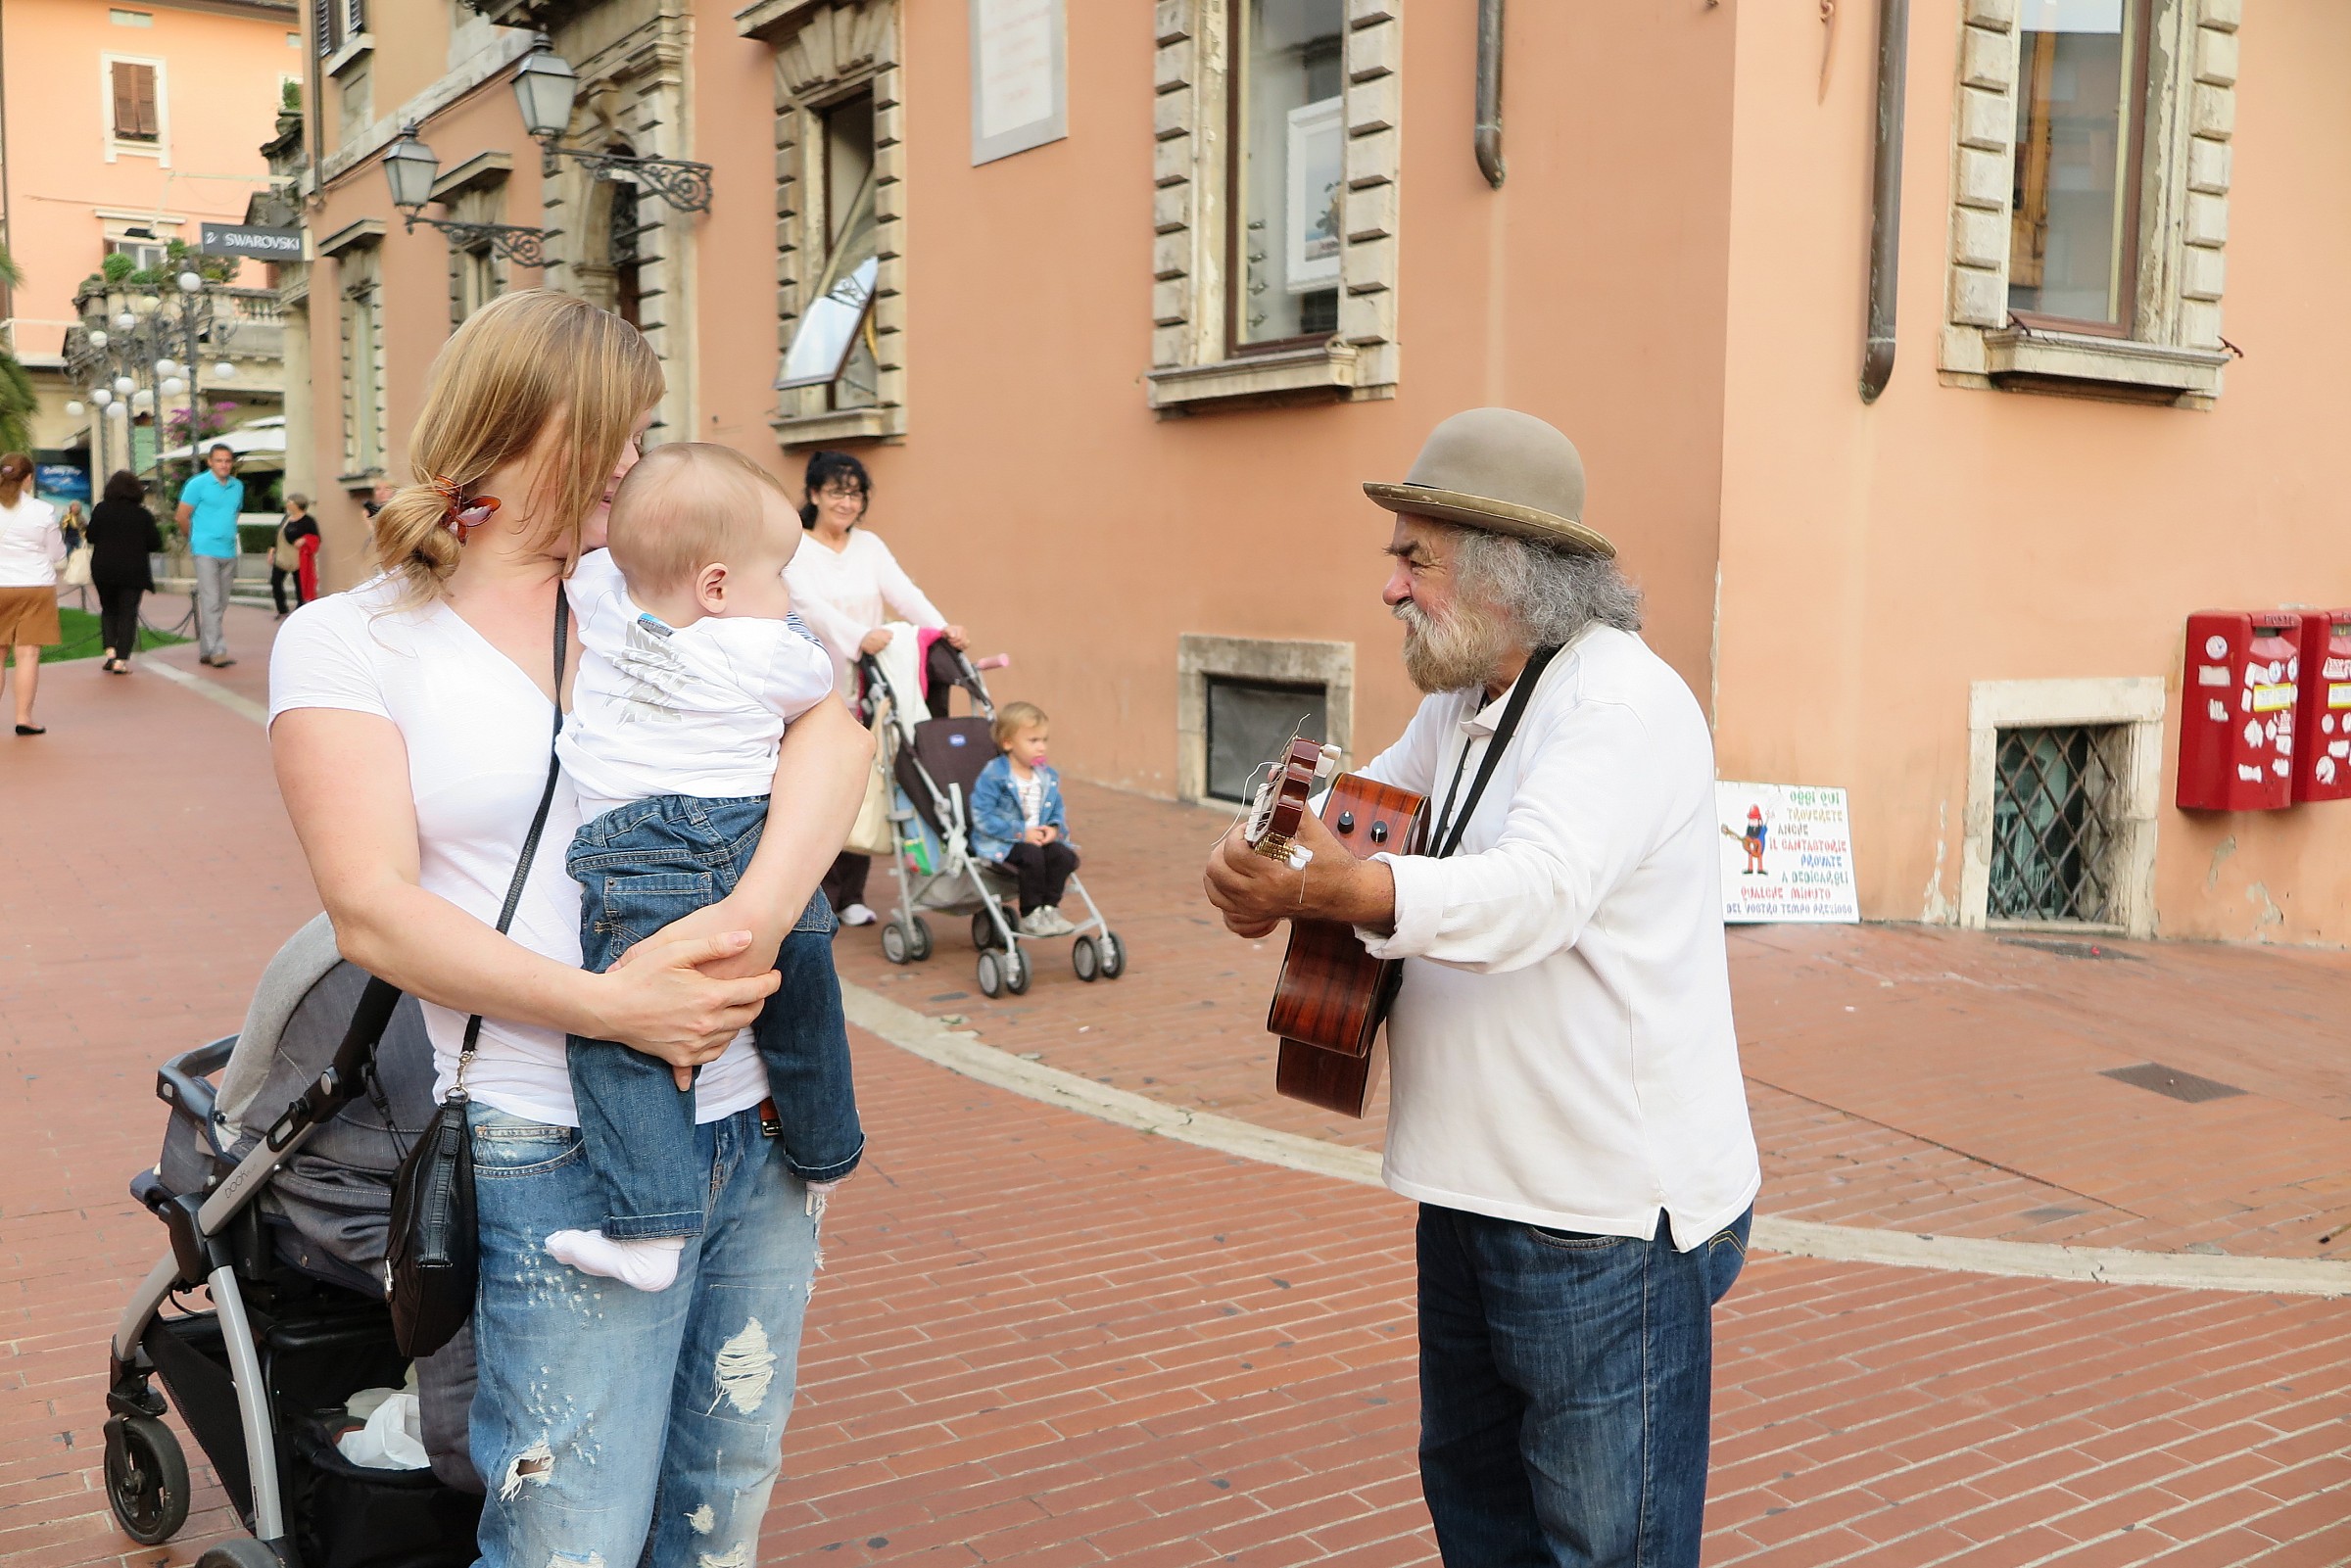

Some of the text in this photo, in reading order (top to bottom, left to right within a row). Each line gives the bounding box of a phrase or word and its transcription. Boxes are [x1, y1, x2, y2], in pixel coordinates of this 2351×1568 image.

[224, 233, 300, 251] SWAROVSKI
[1790, 790, 1840, 806] OGGI QUI
[1787, 807, 1843, 823] TROVERETE
[1778, 823, 1808, 836] ANCHE
[1769, 836, 1847, 852] IL CANTASTORIE
[1800, 853, 1843, 869] PROVATE
[1782, 871, 1848, 885] A DEDICARGLI
[1741, 885, 1831, 902] QUALCHE MINUTO
[1726, 902, 1852, 915] DEL VOSTRO TEMPO PREZIOSO
